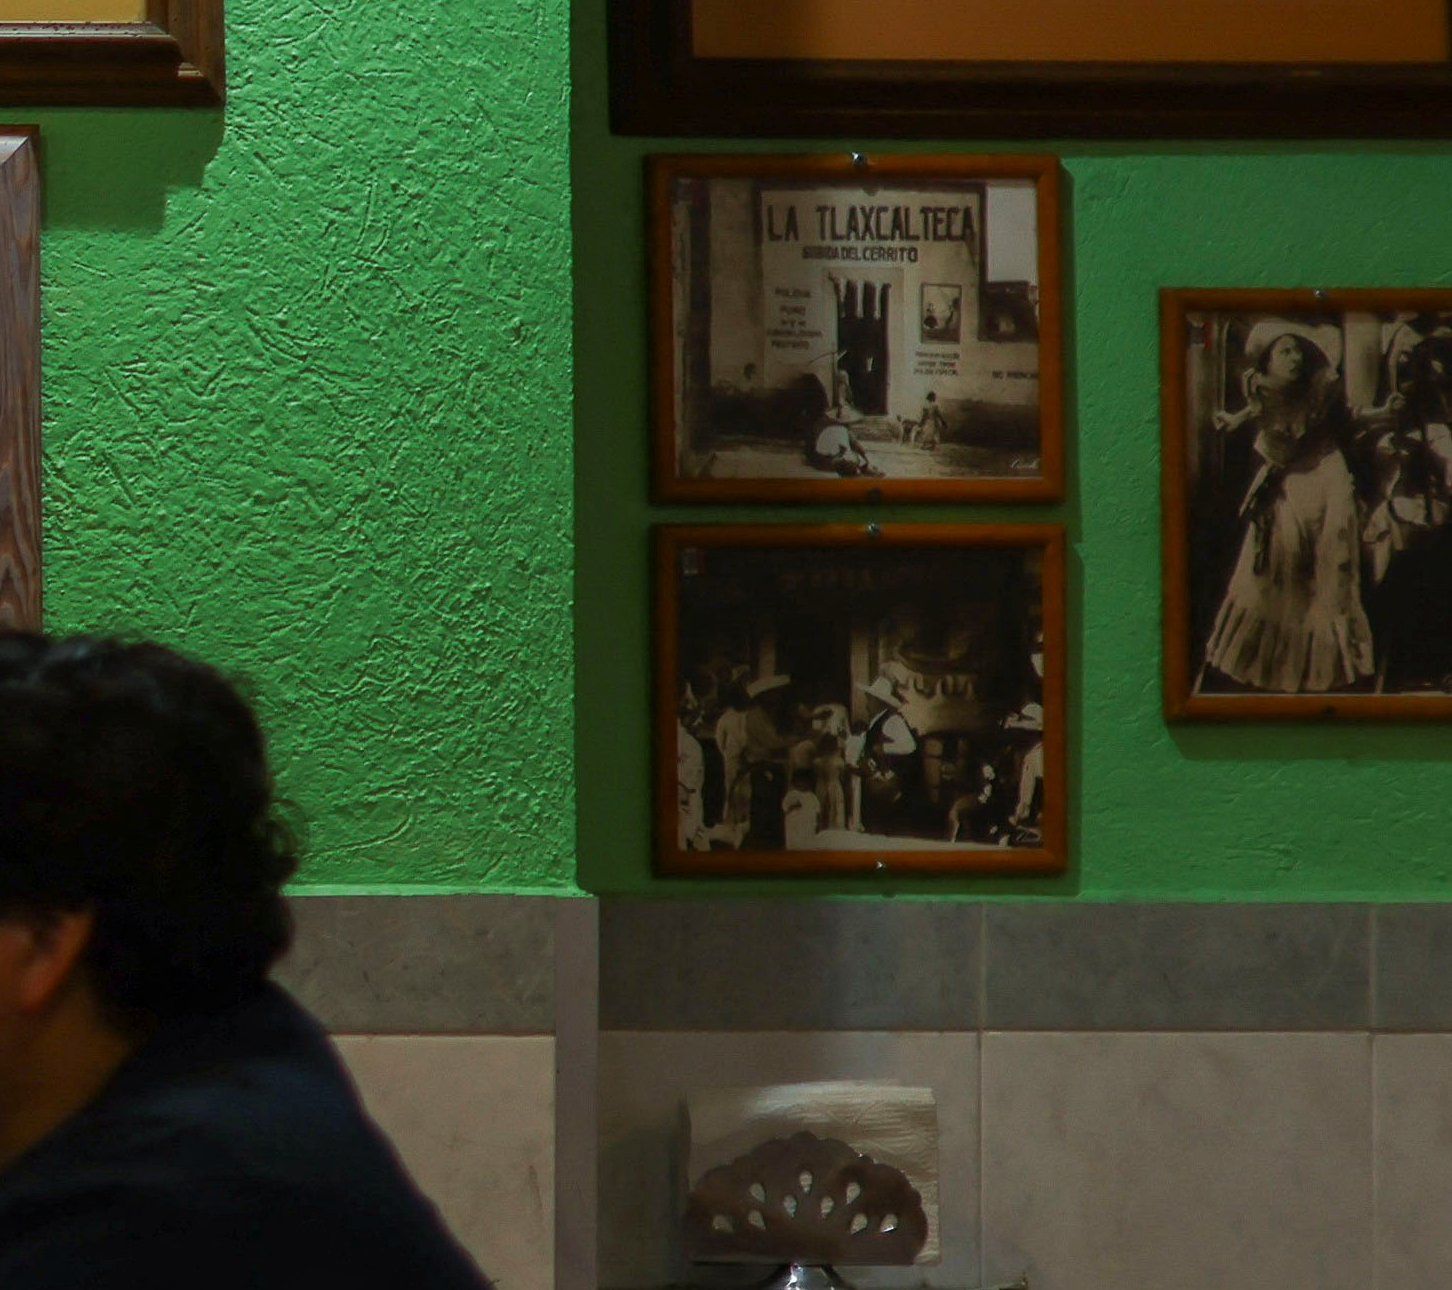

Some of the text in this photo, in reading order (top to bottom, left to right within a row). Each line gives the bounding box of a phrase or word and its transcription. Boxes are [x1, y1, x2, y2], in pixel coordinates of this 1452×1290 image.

[767, 205, 975, 242] LA TLAXCALTECA
[841, 246, 861, 260] DEL
[863, 246, 919, 263] CERRITO
